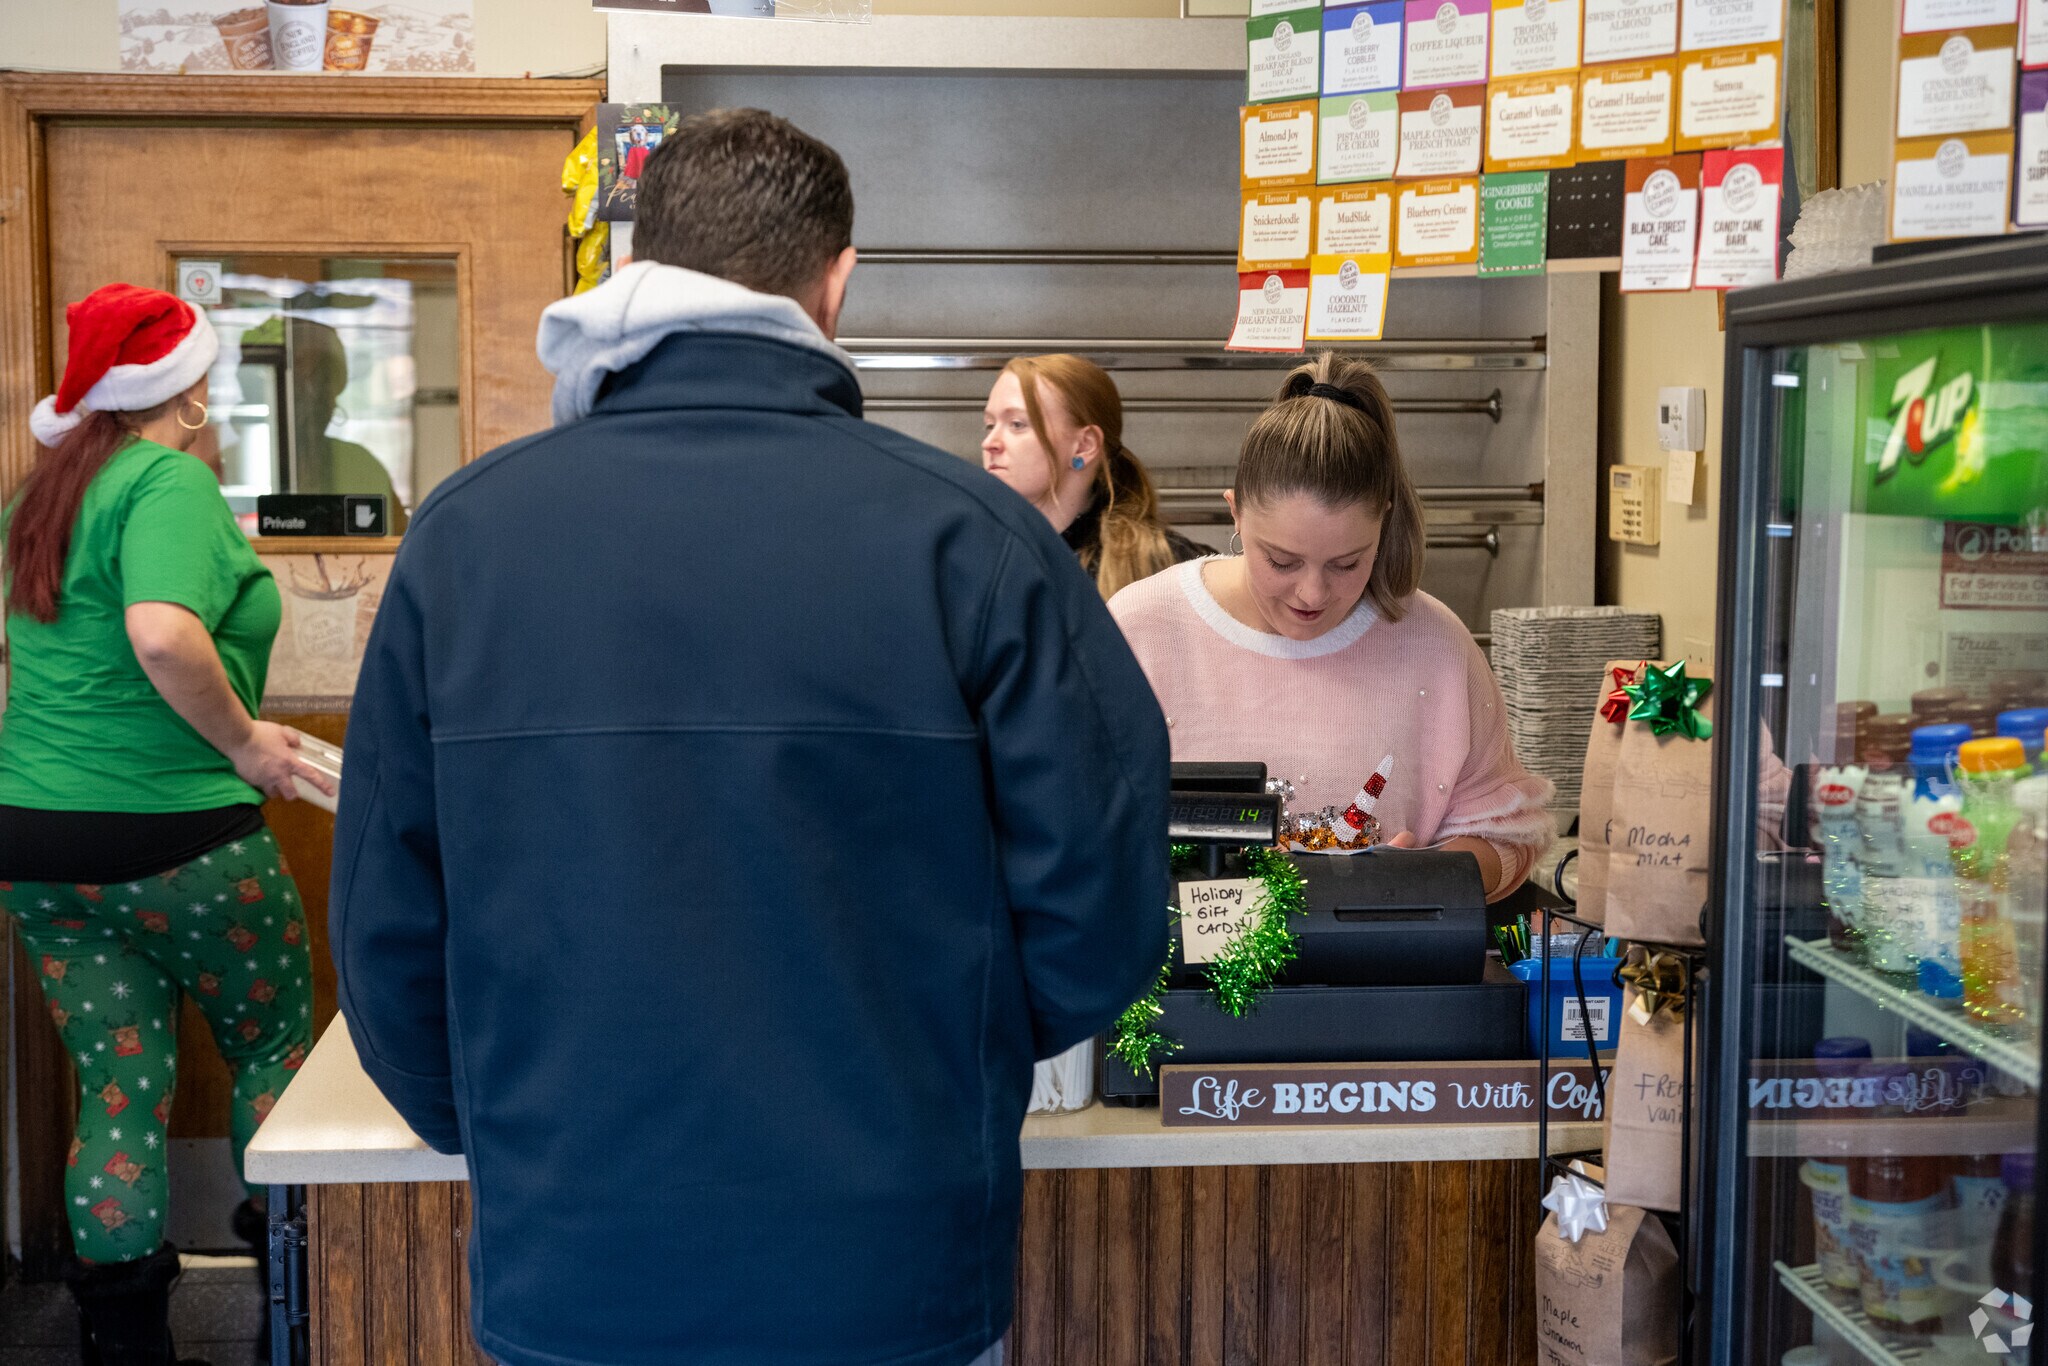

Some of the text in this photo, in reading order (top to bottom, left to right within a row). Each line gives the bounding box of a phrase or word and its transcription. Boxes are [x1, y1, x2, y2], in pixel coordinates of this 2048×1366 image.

[1586, 3, 1674, 23] SWISS CHOCOLATE
[1709, 2, 1754, 16] CRUNCH
[1609, 17, 1651, 31] ALMOND
[1709, 16, 1752, 26] FLAVORED
[1514, 22, 1558, 36] TROPICAL
[1514, 32, 1558, 46] COCONUT
[1610, 32, 1650, 42] FLAVORED
[1410, 35, 1484, 52] COFFEE LIQUEUR
[1278, 51, 1302, 60] ENGLAND
[1344, 44, 1380, 56] BLUEBERRY
[1516, 46, 1554, 56] FLAVORED
[1347, 54, 1376, 65] COBBLER
[1428, 53, 1464, 62] FLAVORED
[1253, 56, 1314, 72] BREAKFAST BLEND
[1344, 66, 1378, 74] FLAVORED
[1272, 68, 1294, 78] DECAF
[1611, 70, 1644, 81] Flavored
[1260, 76, 1306, 88] MEDIUM ROAST
[1713, 80, 1744, 92] Samoa
[1516, 85, 1547, 95] Flavored
[1588, 92, 1665, 109] Caramel Hazelnut
[1266, 109, 1292, 120] Flavored
[1499, 104, 1563, 121] Caramel Vanilla
[1260, 129, 1299, 142] Almond Joy
[1337, 129, 1380, 142] PISTACHIO
[1402, 126, 1480, 141] MAPLE CINNAMON
[1336, 139, 1380, 152] ICE CREAM
[1408, 136, 1472, 150] FRENCH TOAST
[1340, 152, 1374, 160] FLAVORED
[1422, 150, 1458, 158] FLAVORED
[1423, 182, 1452, 194] Flavored
[1484, 182, 1544, 197] GINGERBREAD
[1896, 180, 2004, 197] VANILLA HAZELNUT
[1264, 194, 1290, 203] Flavored
[1342, 190, 1368, 200] Flavored
[1494, 196, 1534, 210] COOKIE
[1338, 211, 1372, 224] MudSlide
[1406, 206, 1442, 218] Blueberry
[1253, 212, 1300, 226] Snickerdoodle
[1495, 214, 1534, 224] FLAVORED
[1631, 220, 1686, 234] BLACK FOREST
[1713, 219, 1764, 234] CANDY CANE
[1649, 233, 1668, 246] CAKE
[1725, 234, 1748, 246] BARK
[1329, 294, 1367, 304] COCONUT
[1327, 304, 1368, 314] HAZELNUT
[1238, 314, 1303, 325] BREAKFAST BLEND
[262, 516, 307, 530] Private
[1977, 578, 2028, 590] Service
[1180, 1076, 1267, 1120] Life
[1272, 1081, 1436, 1114] BEGINS
[1448, 1082, 1535, 1110] With
[1542, 1296, 1580, 1328] Maple
